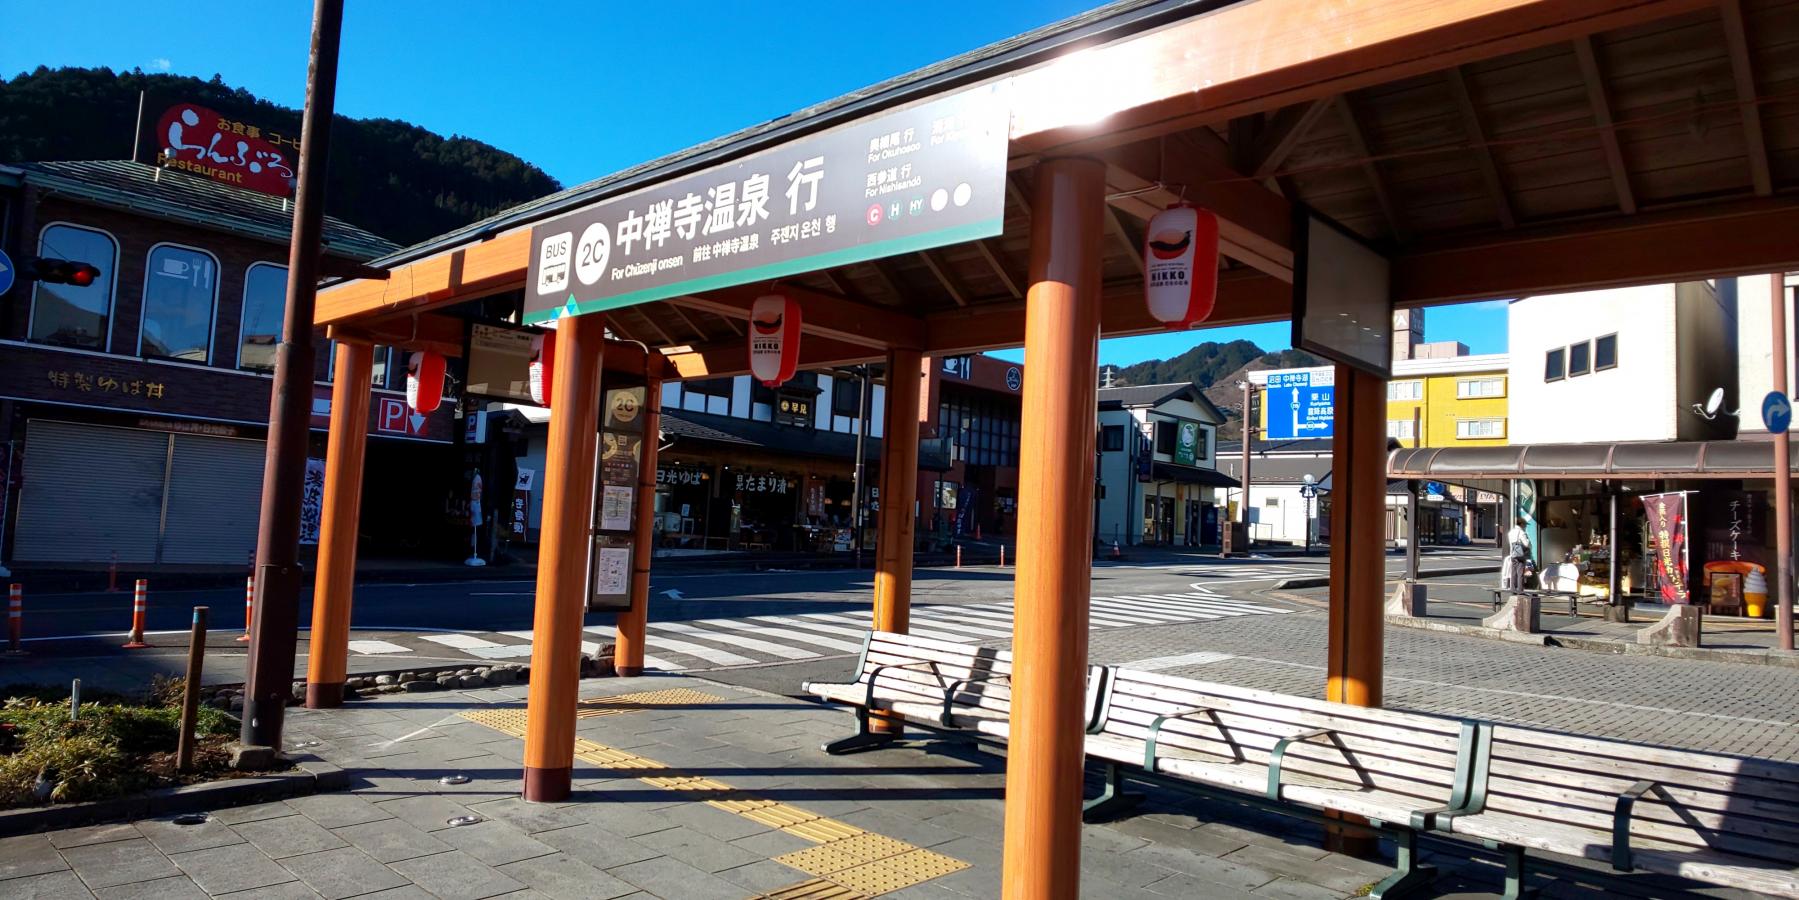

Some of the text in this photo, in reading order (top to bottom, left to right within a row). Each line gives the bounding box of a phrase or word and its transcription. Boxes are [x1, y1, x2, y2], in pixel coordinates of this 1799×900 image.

[168, 108, 293, 178] らんぶる
[217, 117, 301, 151] お食事 コーヒ
[157, 152, 243, 184] Restaurant
[867, 152, 880, 164] For
[900, 163, 912, 179] 行
[615, 155, 824, 256] 中禅寺温泉 行
[865, 187, 878, 198] For
[870, 199, 923, 222] C H HY
[770, 214, 837, 246] 주젠지 온천 행
[545, 240, 567, 260] BUS
[581, 238, 605, 268] 2C
[691, 244, 712, 263] 前往
[611, 267, 625, 281] For
[657, 255, 684, 271] onsen
[385, 400, 403, 430] P
[1729, 500, 1742, 561] チーズケーキ
